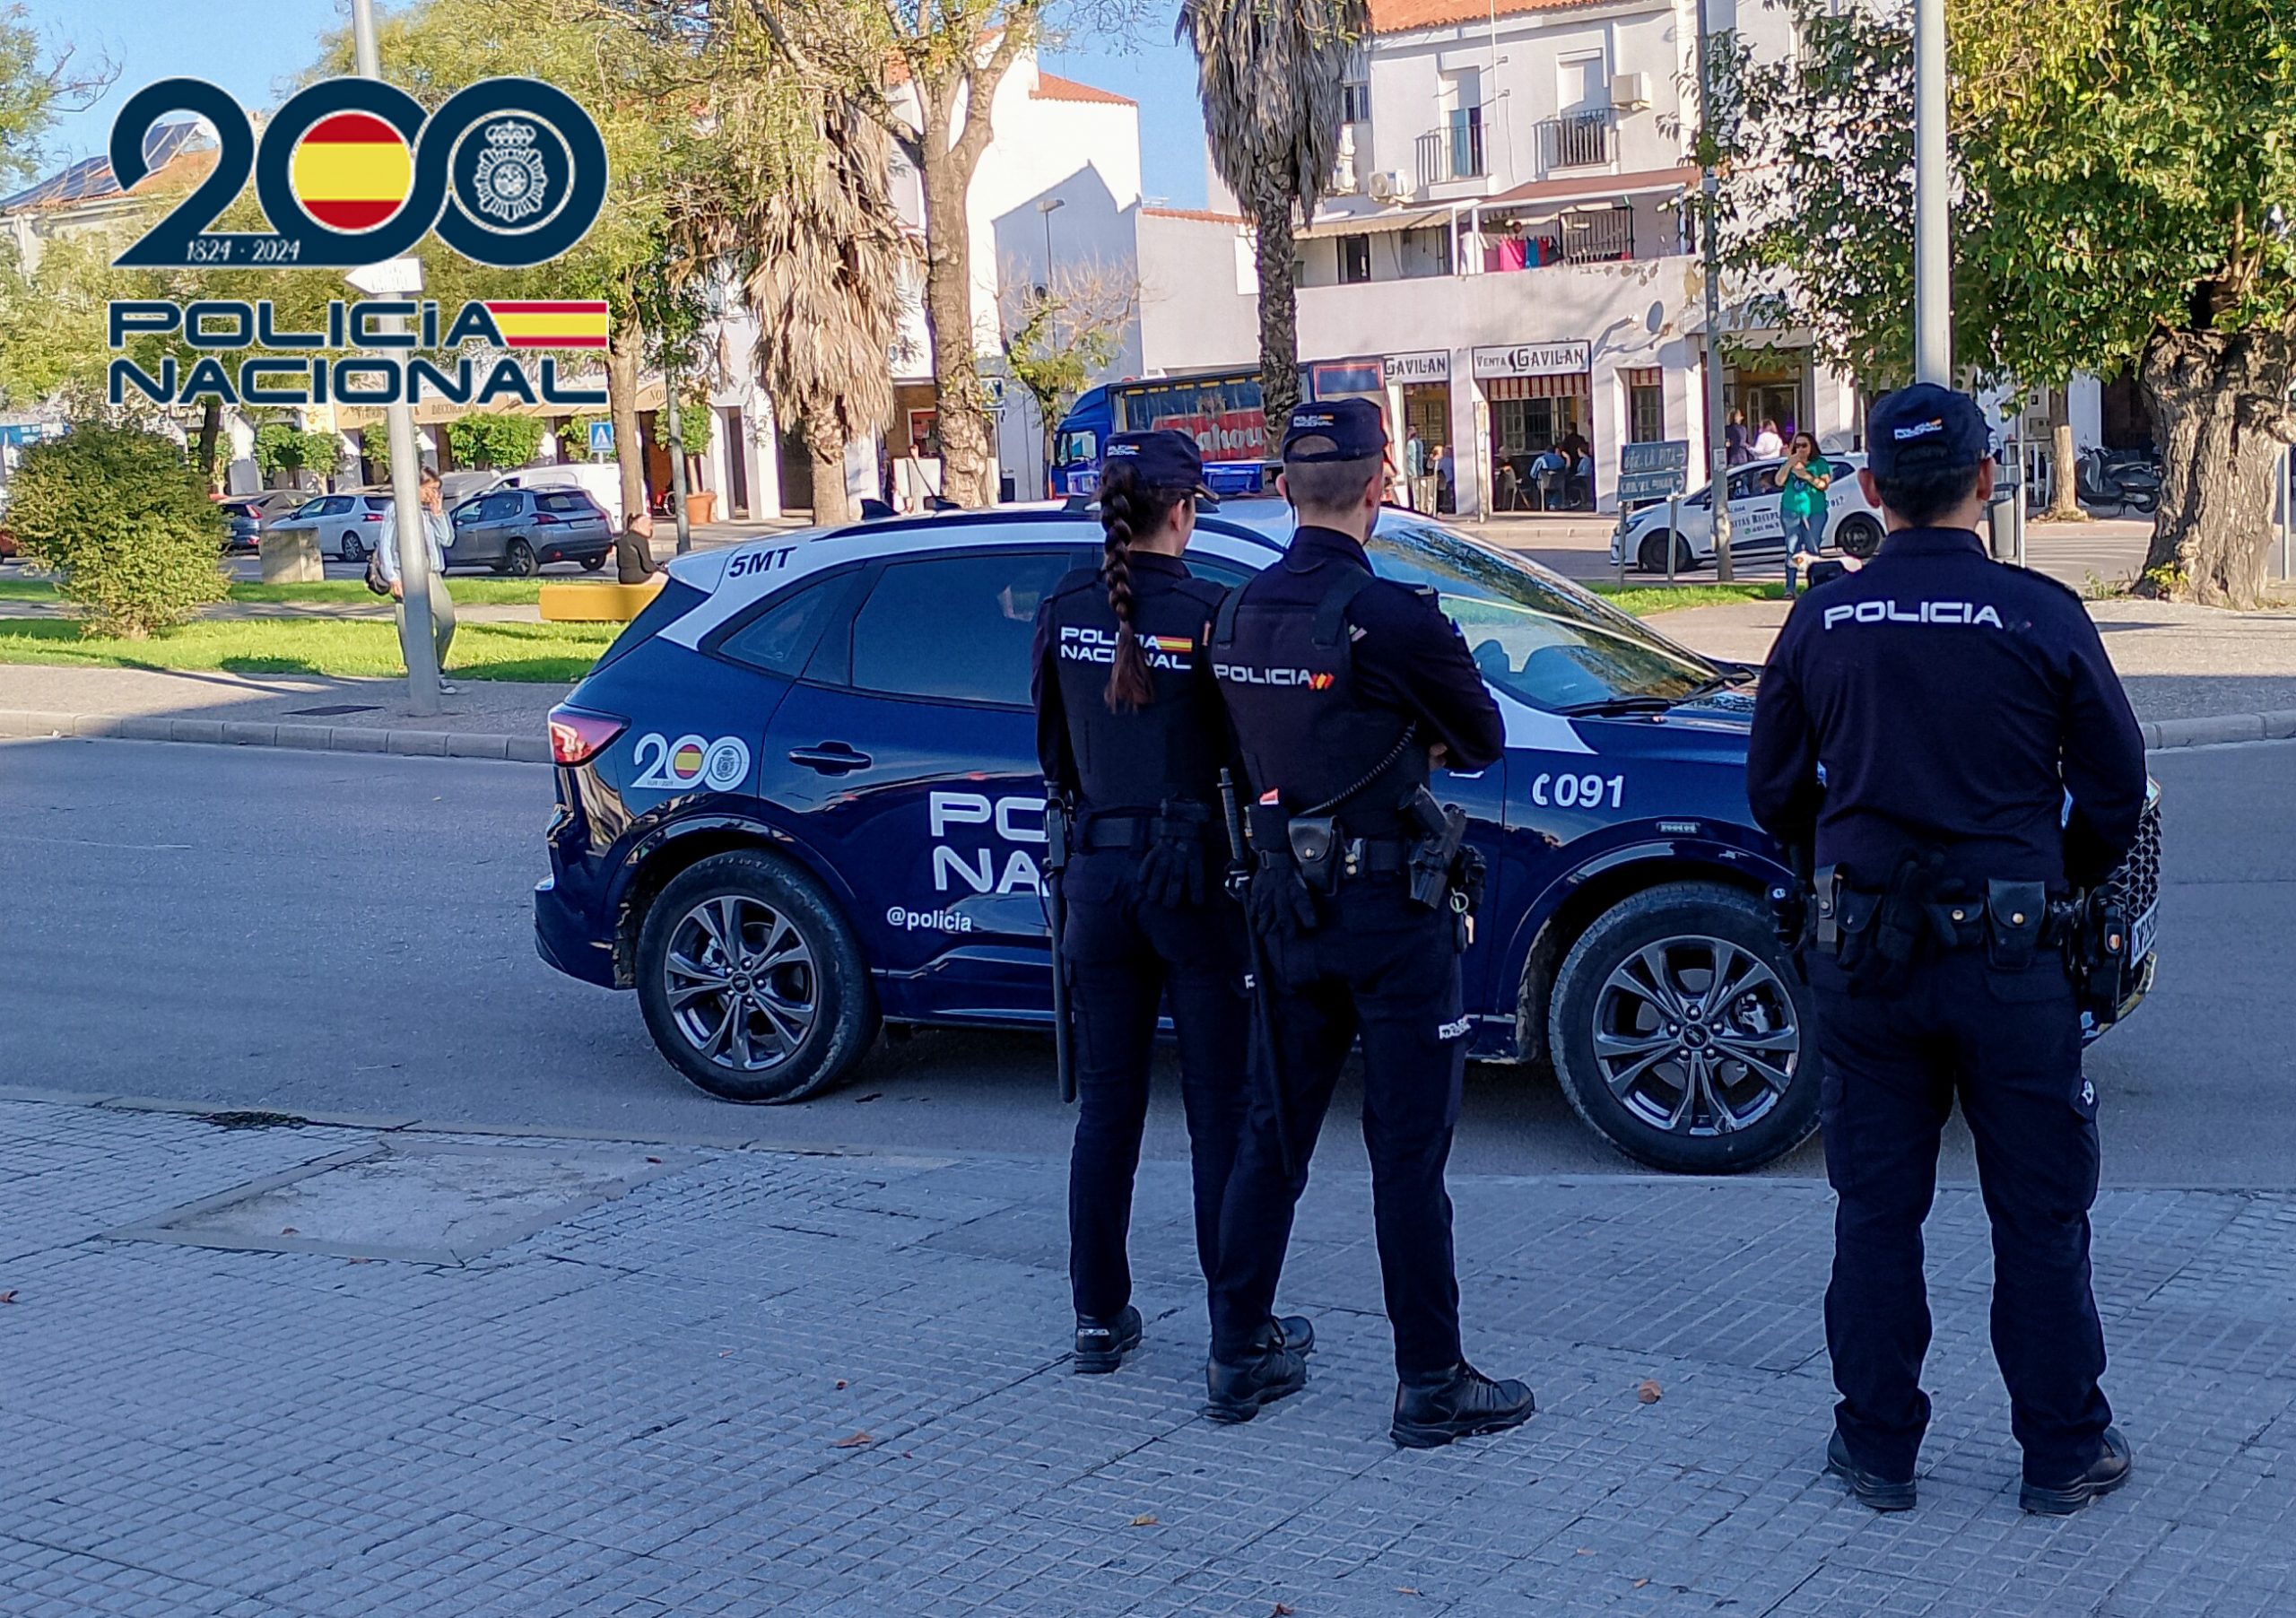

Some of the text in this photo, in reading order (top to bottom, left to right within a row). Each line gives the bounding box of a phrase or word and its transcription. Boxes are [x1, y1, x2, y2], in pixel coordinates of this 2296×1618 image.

[728, 546, 798, 578] 5MT
[1824, 600, 2003, 630] POLICIA
[1061, 627, 1161, 649] POLIIA
[1061, 644, 1192, 669] NACINAL
[1213, 664, 1315, 689] POLICIA
[630, 733, 751, 792] 200
[1554, 773, 1624, 808] 091
